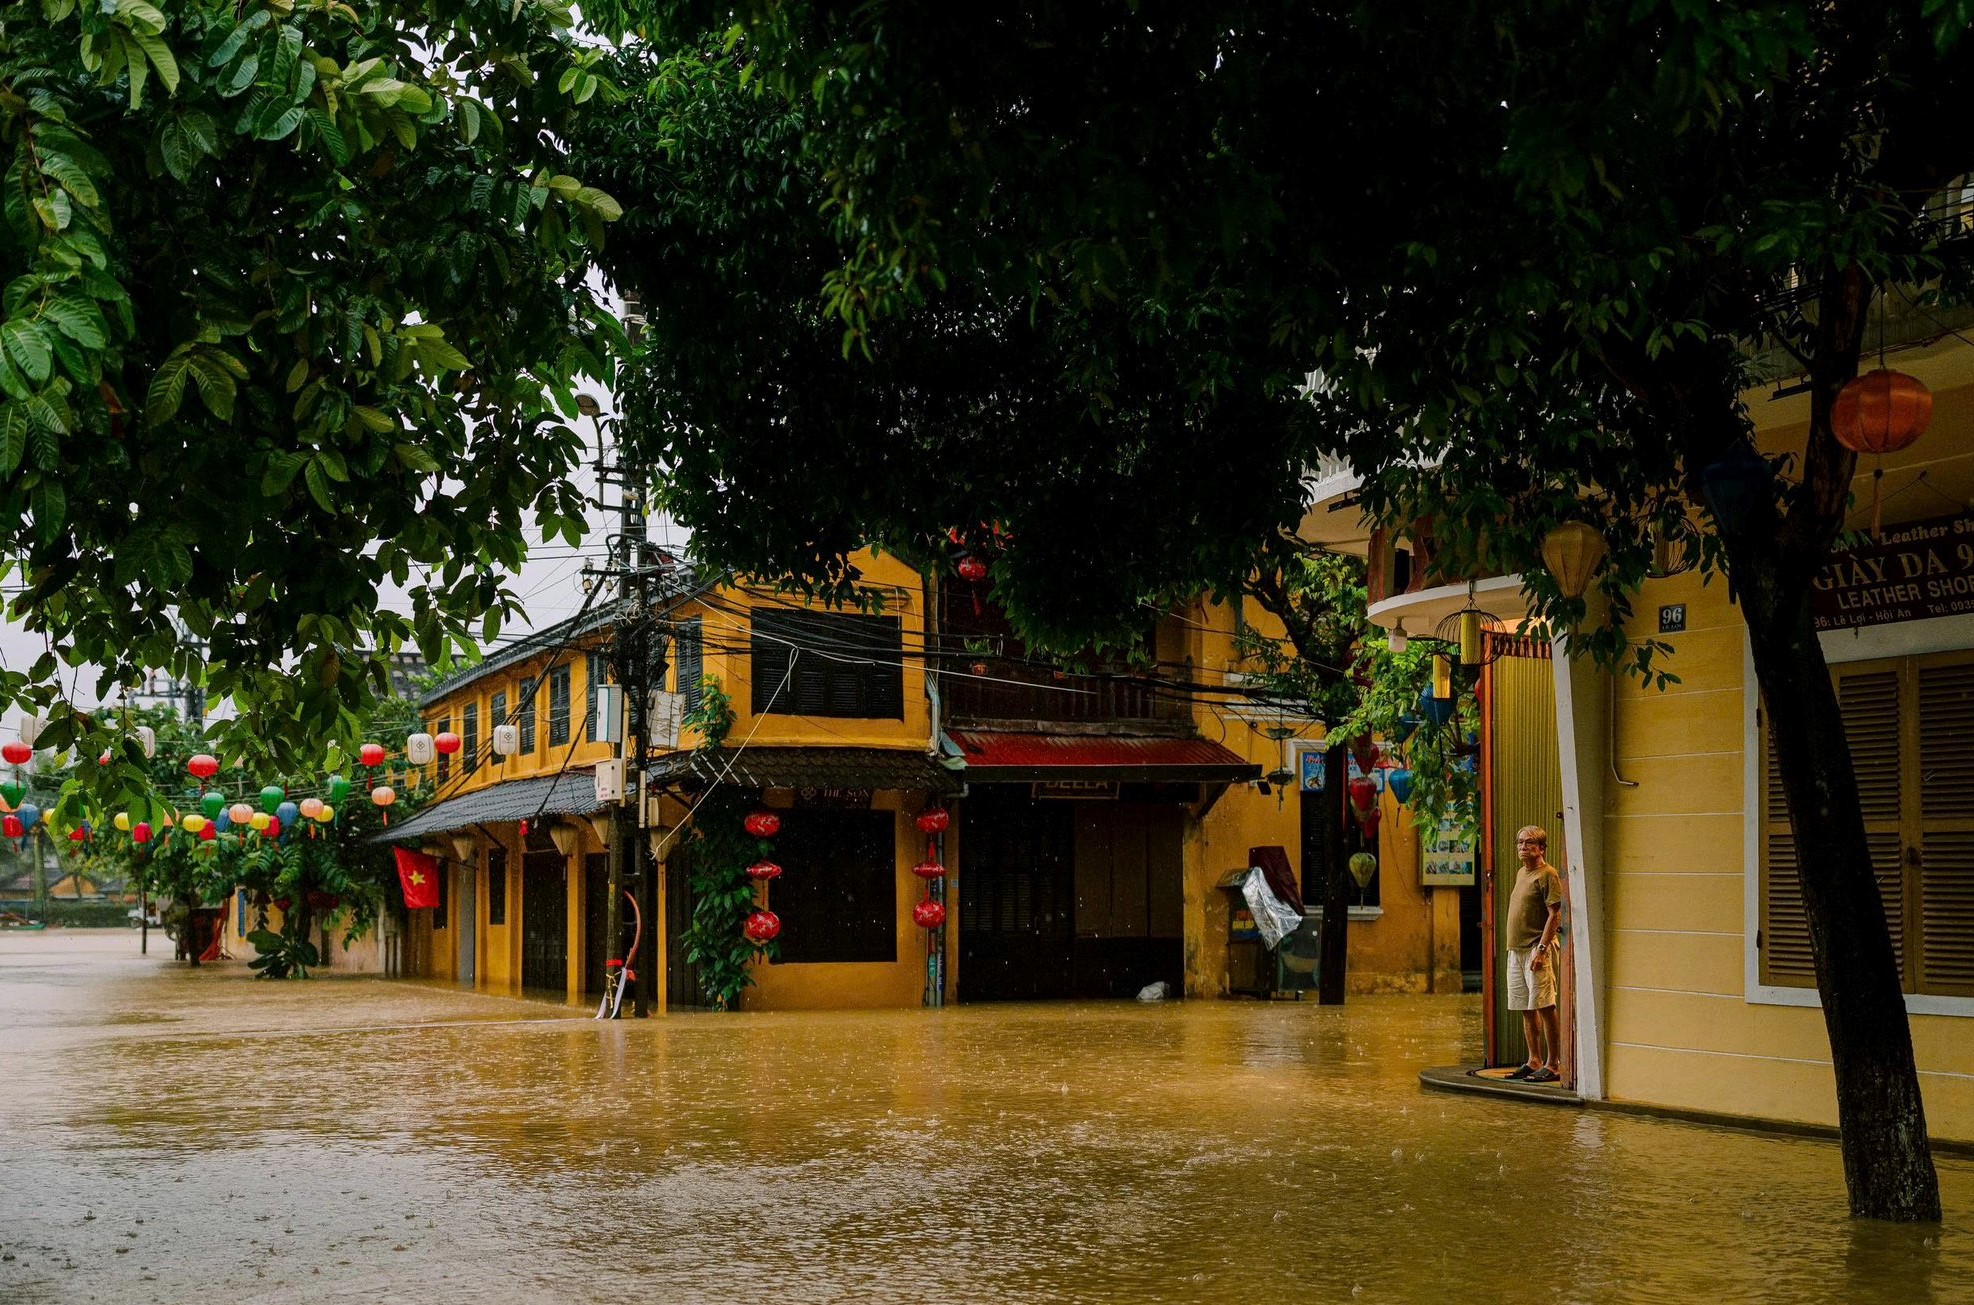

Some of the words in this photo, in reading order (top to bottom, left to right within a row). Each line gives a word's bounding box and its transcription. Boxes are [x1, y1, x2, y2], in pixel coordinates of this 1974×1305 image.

[1879, 526, 1949, 546] Leather
[1812, 554, 1888, 591] GIÀY
[1897, 548, 1950, 579] DA
[1837, 584, 1922, 609] LEATHER
[1662, 607, 1682, 624] 96
[1897, 608, 1912, 618] An
[1926, 603, 1949, 614] Tel:
